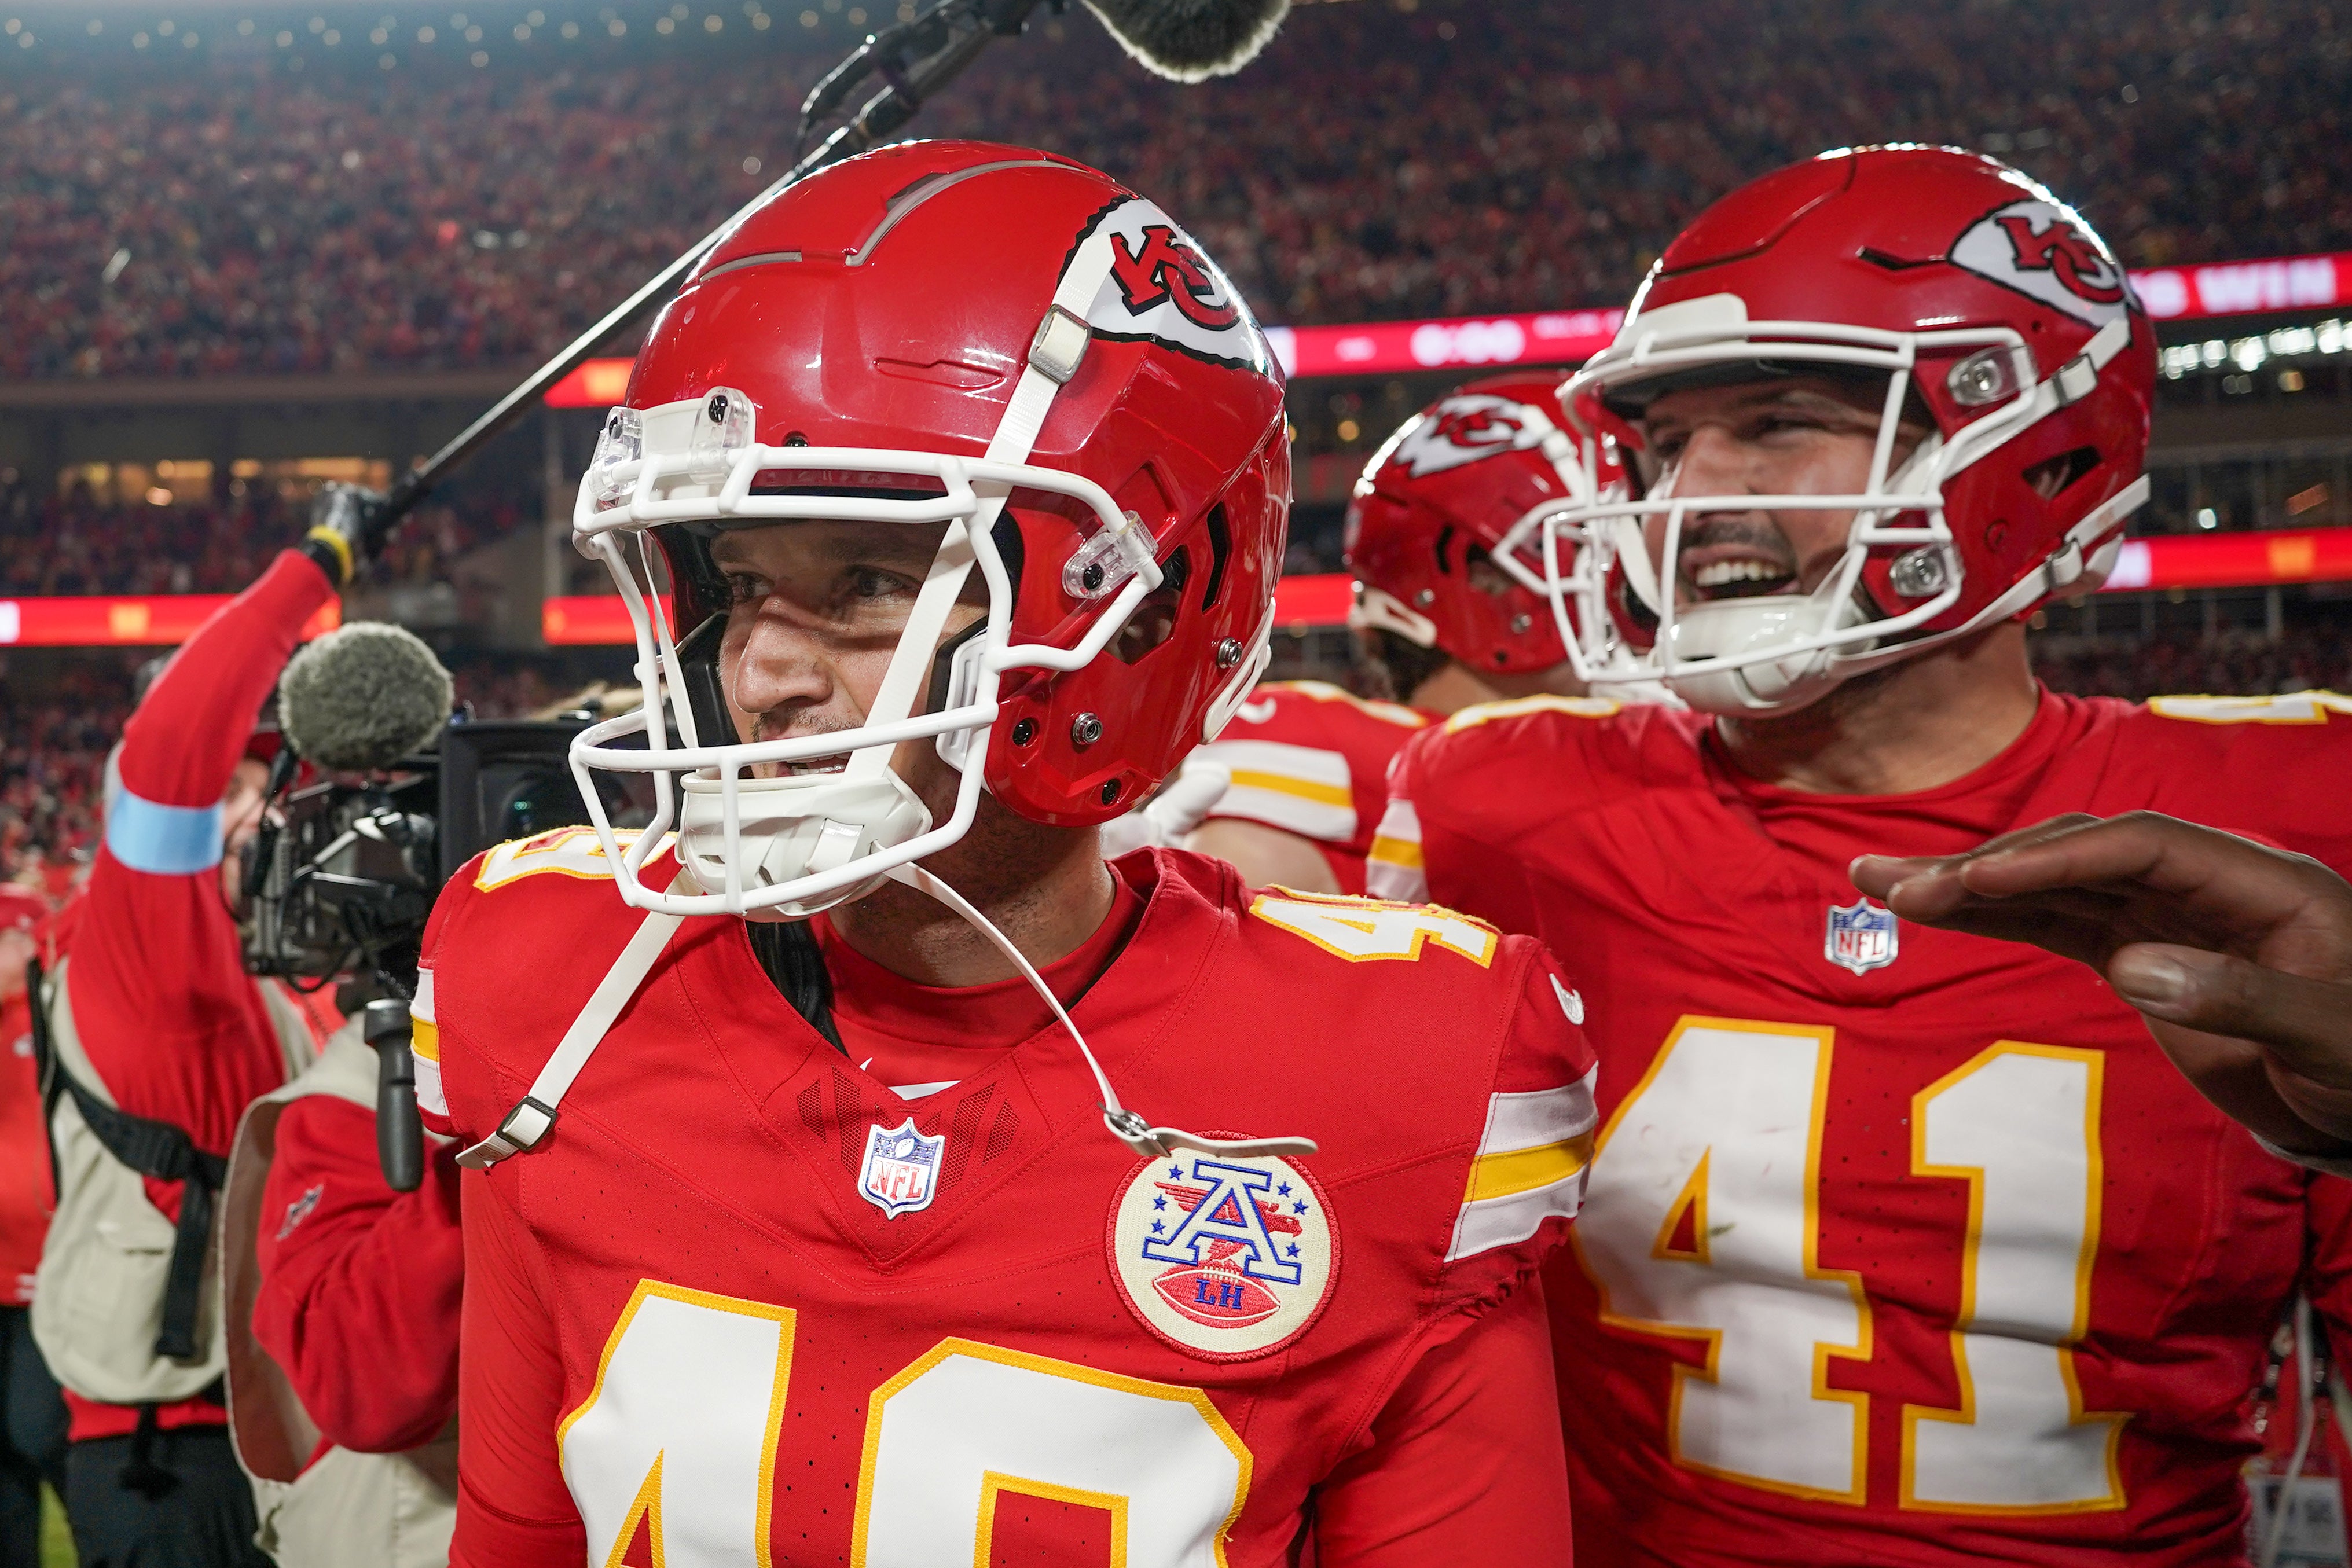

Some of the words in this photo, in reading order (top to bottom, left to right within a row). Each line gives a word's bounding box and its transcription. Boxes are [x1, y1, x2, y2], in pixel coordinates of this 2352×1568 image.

[1838, 930, 1884, 960] NFL
[871, 1159, 922, 1201] NFL
[1568, 1013, 2135, 1516] 41
[1195, 1279, 1244, 1310] LH
